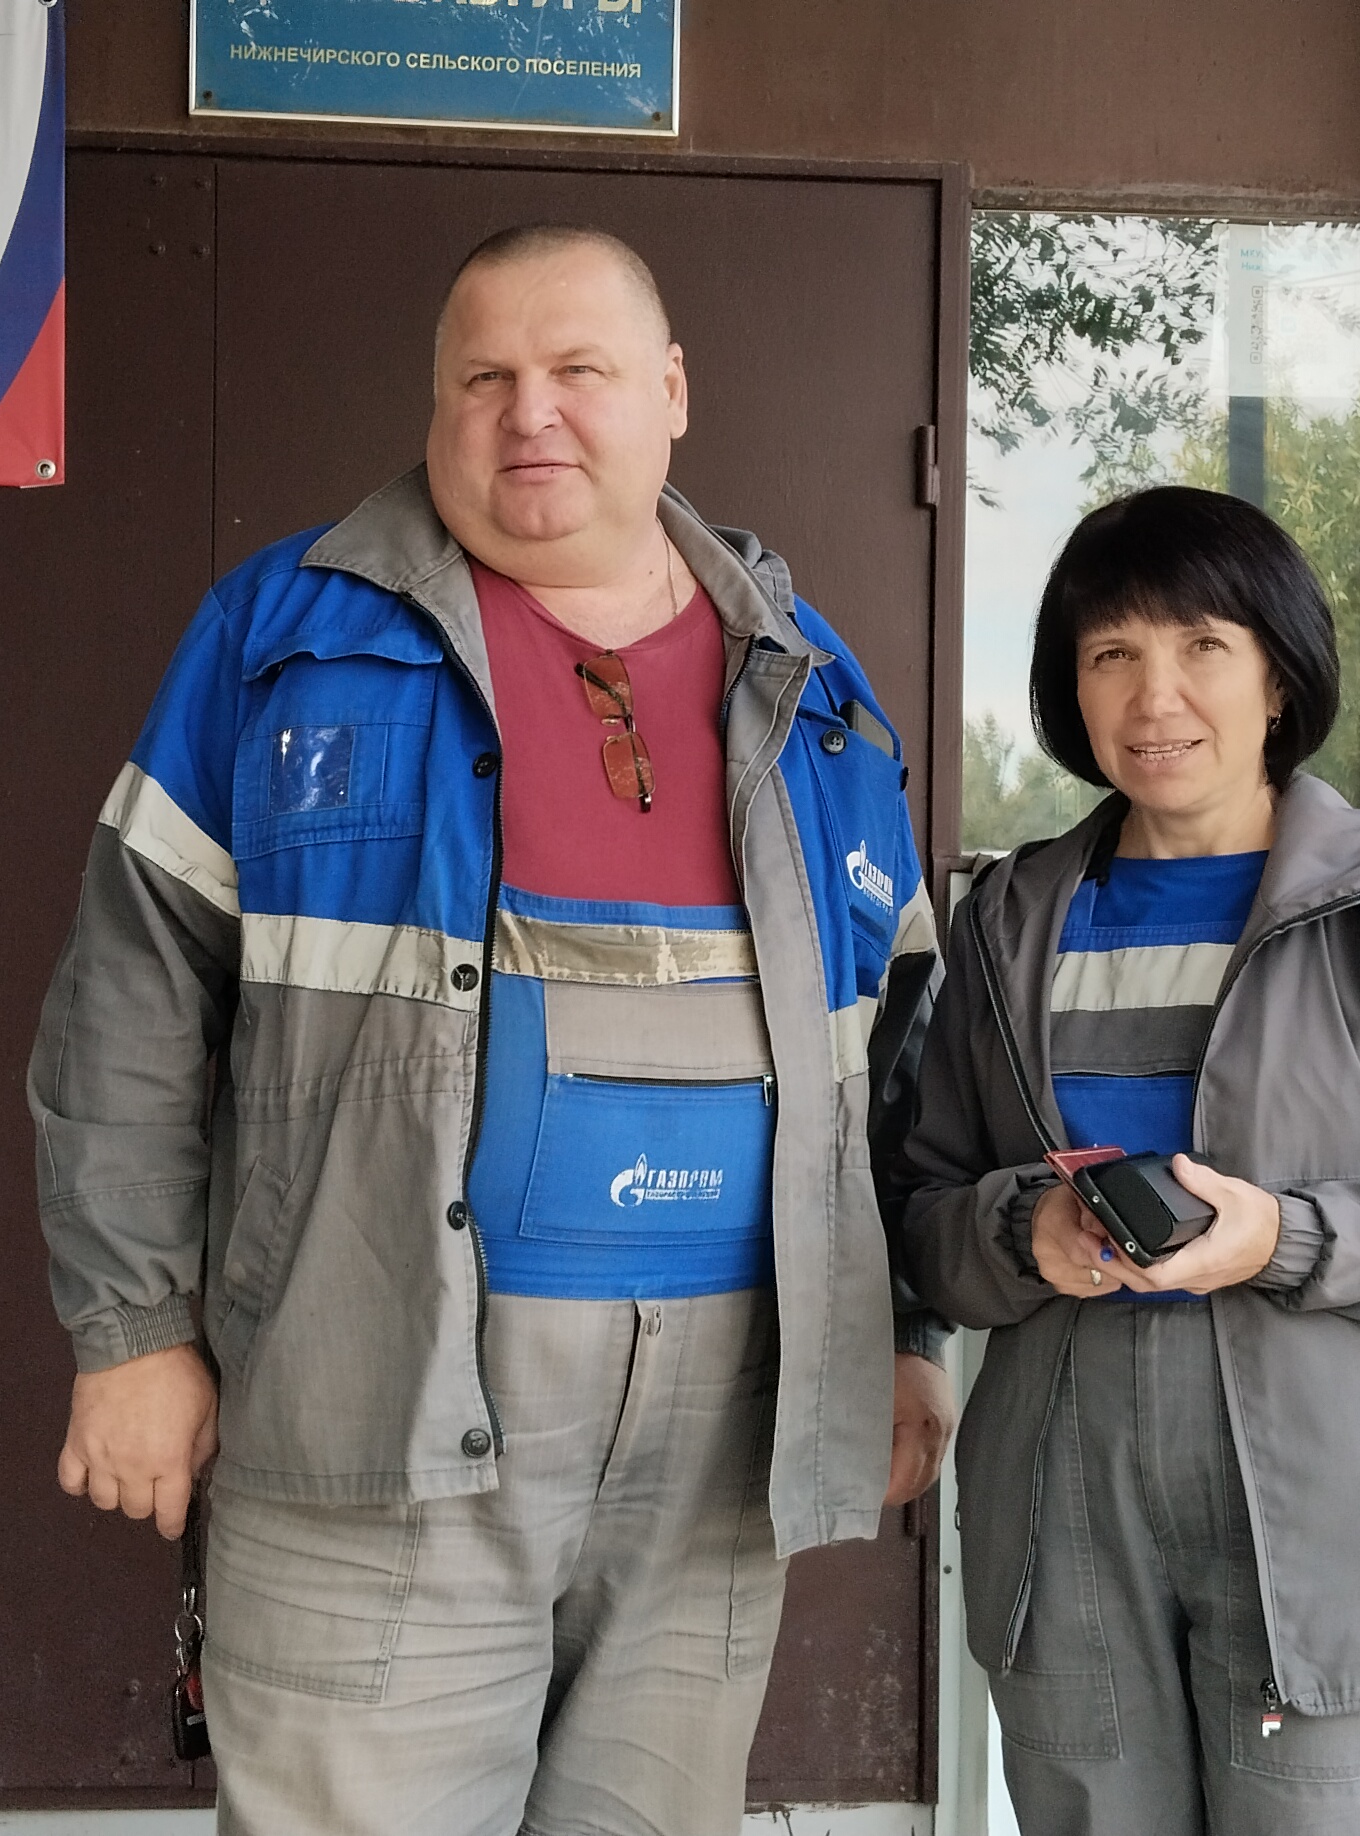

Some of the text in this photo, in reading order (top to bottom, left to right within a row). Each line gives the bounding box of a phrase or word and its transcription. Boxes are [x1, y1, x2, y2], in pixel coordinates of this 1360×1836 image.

[231, 43, 641, 78] НИЖНЕЧИРСКОГО СЕЛЬСКОГО ПОСЕЛЕНИЯ
[647, 1169, 723, 1189] ГАЗПРОМ
